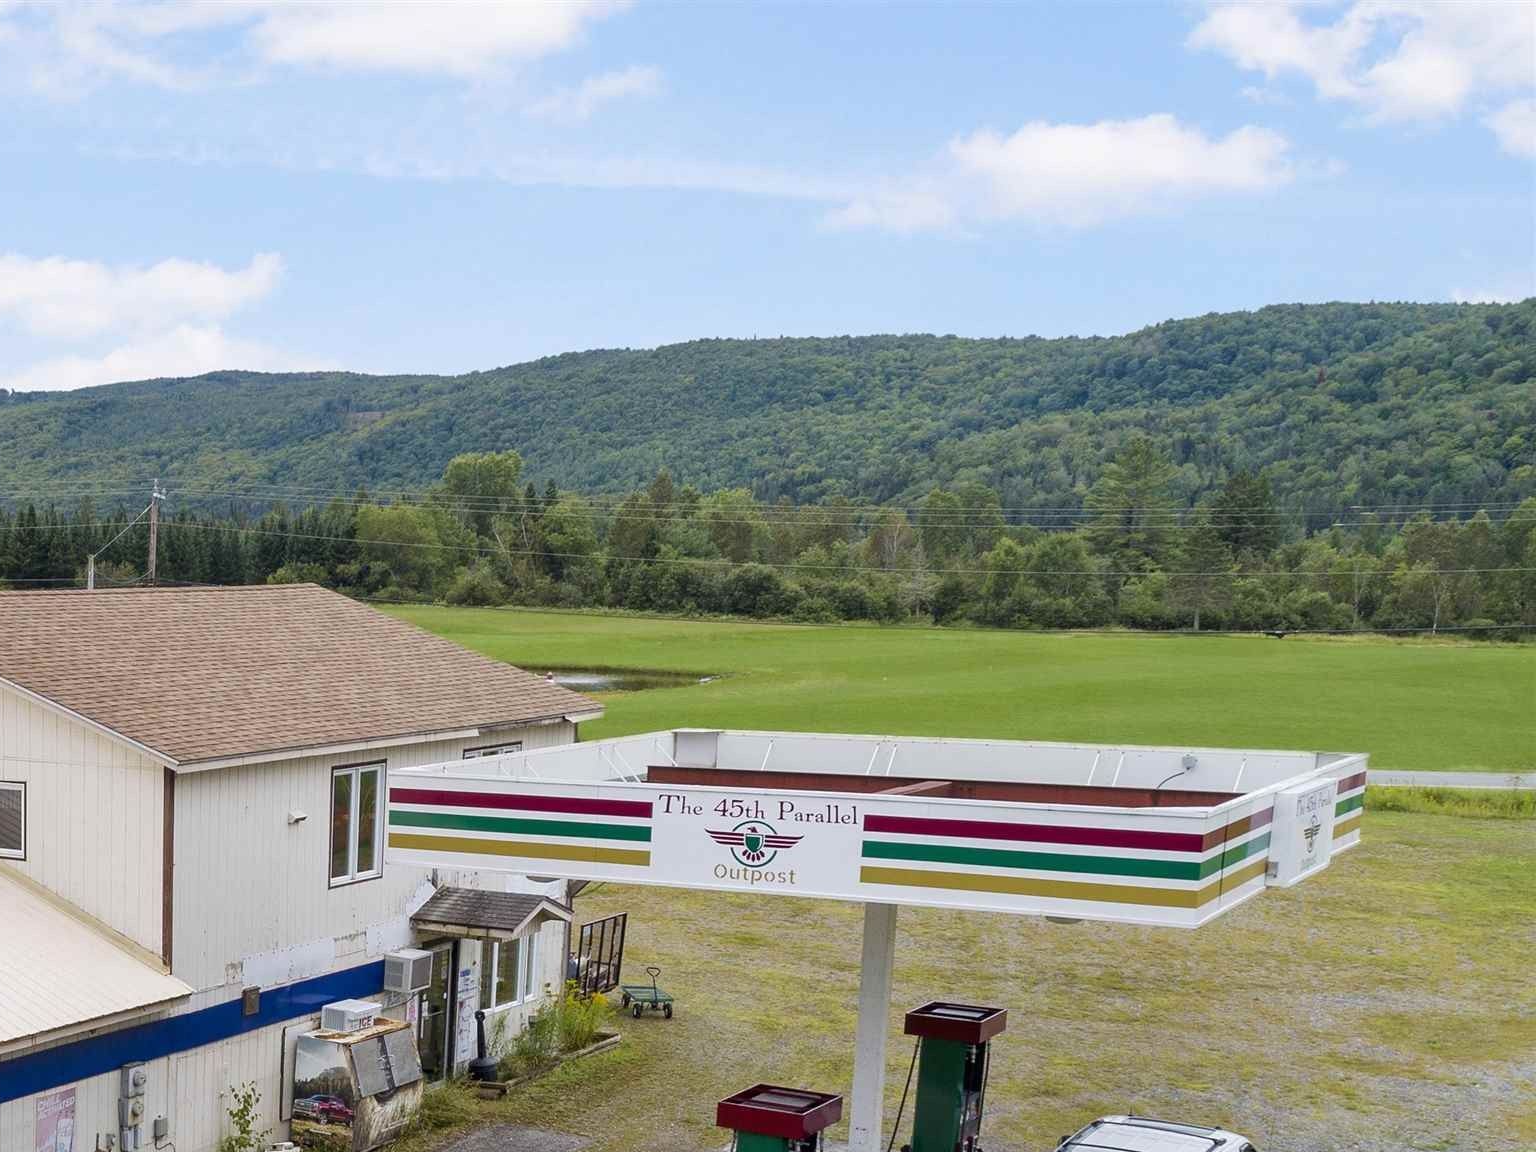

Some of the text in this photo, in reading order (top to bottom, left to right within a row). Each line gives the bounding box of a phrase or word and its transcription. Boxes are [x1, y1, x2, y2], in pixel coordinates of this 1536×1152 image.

[659, 794, 858, 825] The 45th Parallel
[713, 863, 797, 885] Outpost
[359, 1015, 373, 1028] ICE
